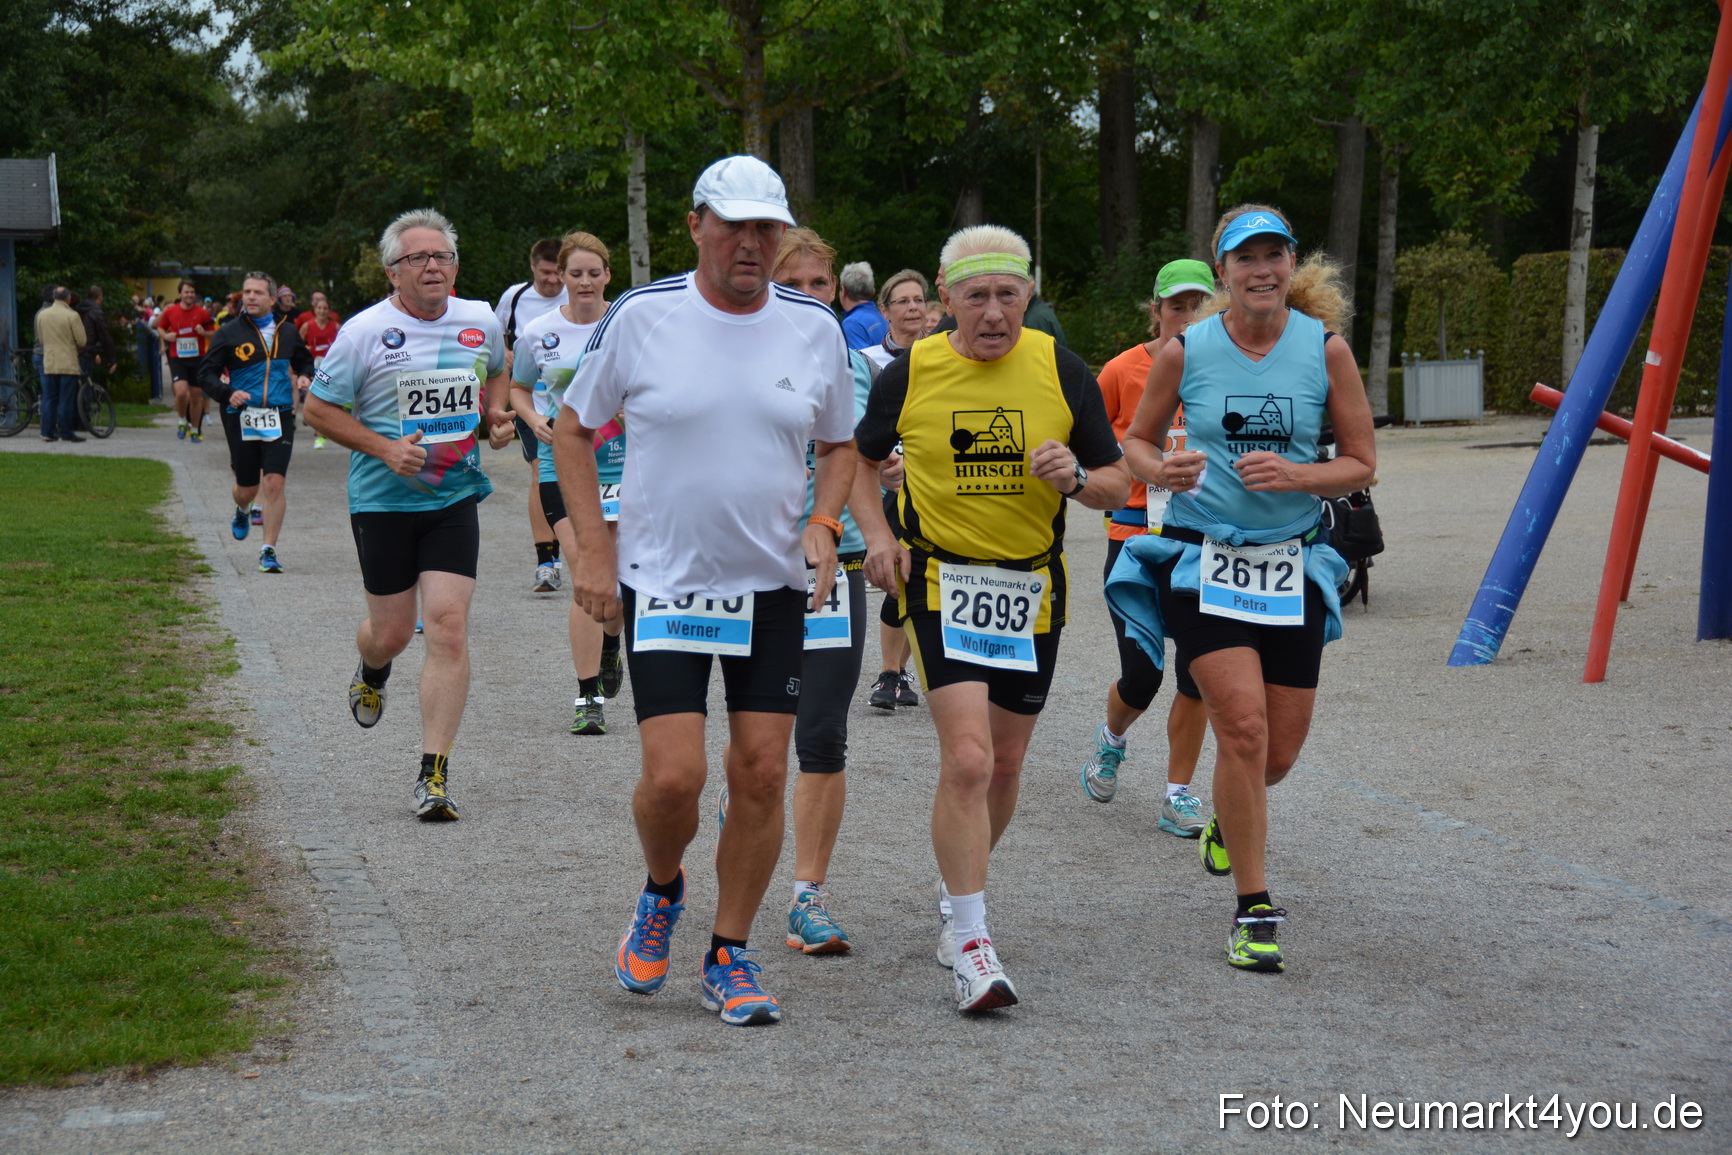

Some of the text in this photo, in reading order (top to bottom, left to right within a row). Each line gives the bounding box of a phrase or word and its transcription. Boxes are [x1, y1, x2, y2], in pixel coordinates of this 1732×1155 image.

[384, 350, 411, 361] PARTL
[399, 375, 466, 387] PARTL Neumarkt
[407, 385, 474, 416] 2544
[244, 414, 277, 428] 3115
[417, 420, 466, 434] Wolfgang
[608, 440, 623, 451] 16.
[1227, 442, 1289, 454] HIRSCH
[954, 464, 1025, 478] HIRSCH
[1211, 552, 1294, 592] 2612
[942, 572, 1027, 591] PARTL Neumarkt
[950, 589, 1030, 632] 2693
[1233, 595, 1268, 612] Petra
[666, 620, 721, 638] Werner
[960, 634, 1016, 659] Wolfgang
